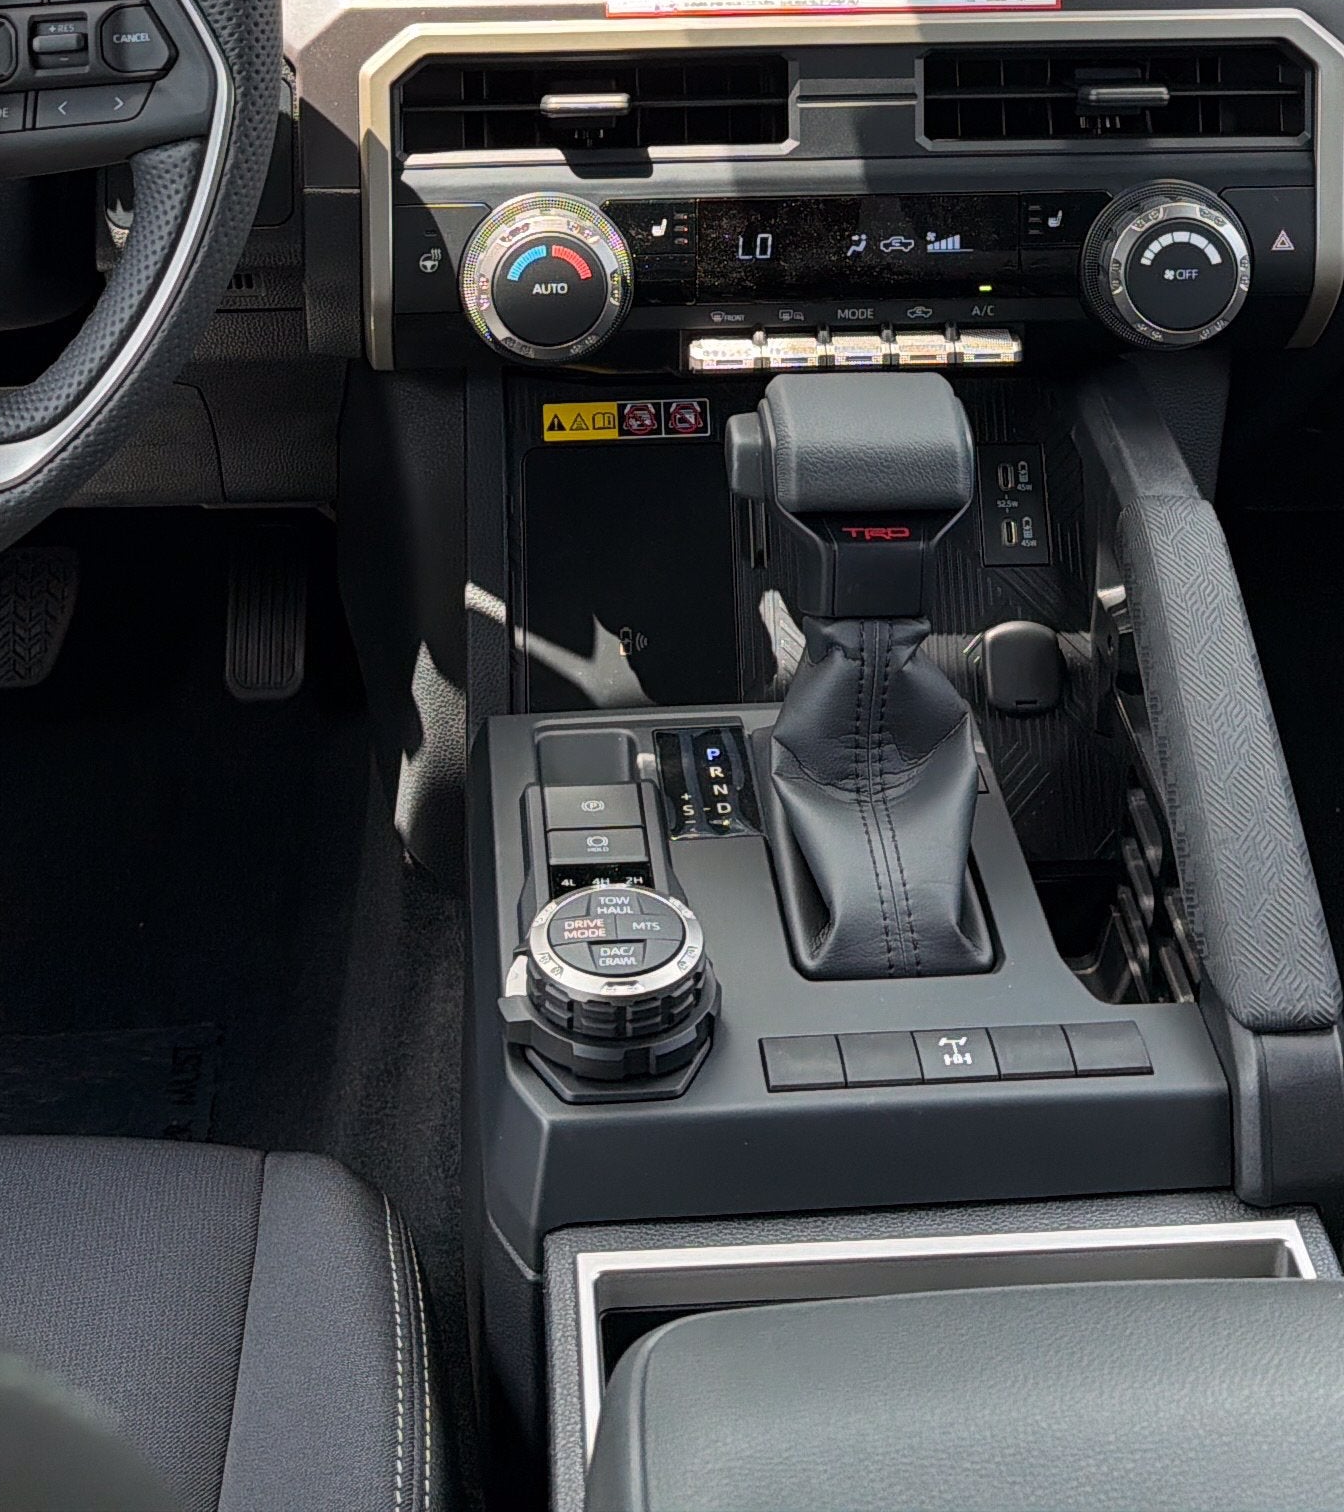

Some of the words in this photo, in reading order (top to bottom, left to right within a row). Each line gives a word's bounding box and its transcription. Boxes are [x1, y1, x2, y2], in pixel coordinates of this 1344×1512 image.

[112, 32, 151, 44] CANCEL
[737, 233, 772, 260] LO
[1175, 268, 1199, 281] OFF
[532, 282, 569, 296] AUTO
[837, 308, 875, 320] MODE
[971, 305, 995, 317] A/C
[724, 313, 746, 322] FRONT
[842, 527, 910, 540] TRD
[706, 748, 720, 761] P
[709, 766, 725, 778] R
[712, 783, 729, 796] N
[682, 804, 695, 816] S
[716, 802, 732, 814] D
[561, 878, 576, 887] 4L
[592, 877, 610, 886] 4H
[598, 896, 630, 905] TOW
[597, 905, 634, 915] HAUL
[564, 918, 604, 930] DRIVE
[632, 920, 661, 932] MTS
[563, 928, 606, 940] MODE
[599, 945, 636, 957] DAC/
[598, 955, 638, 967] CRAWL
